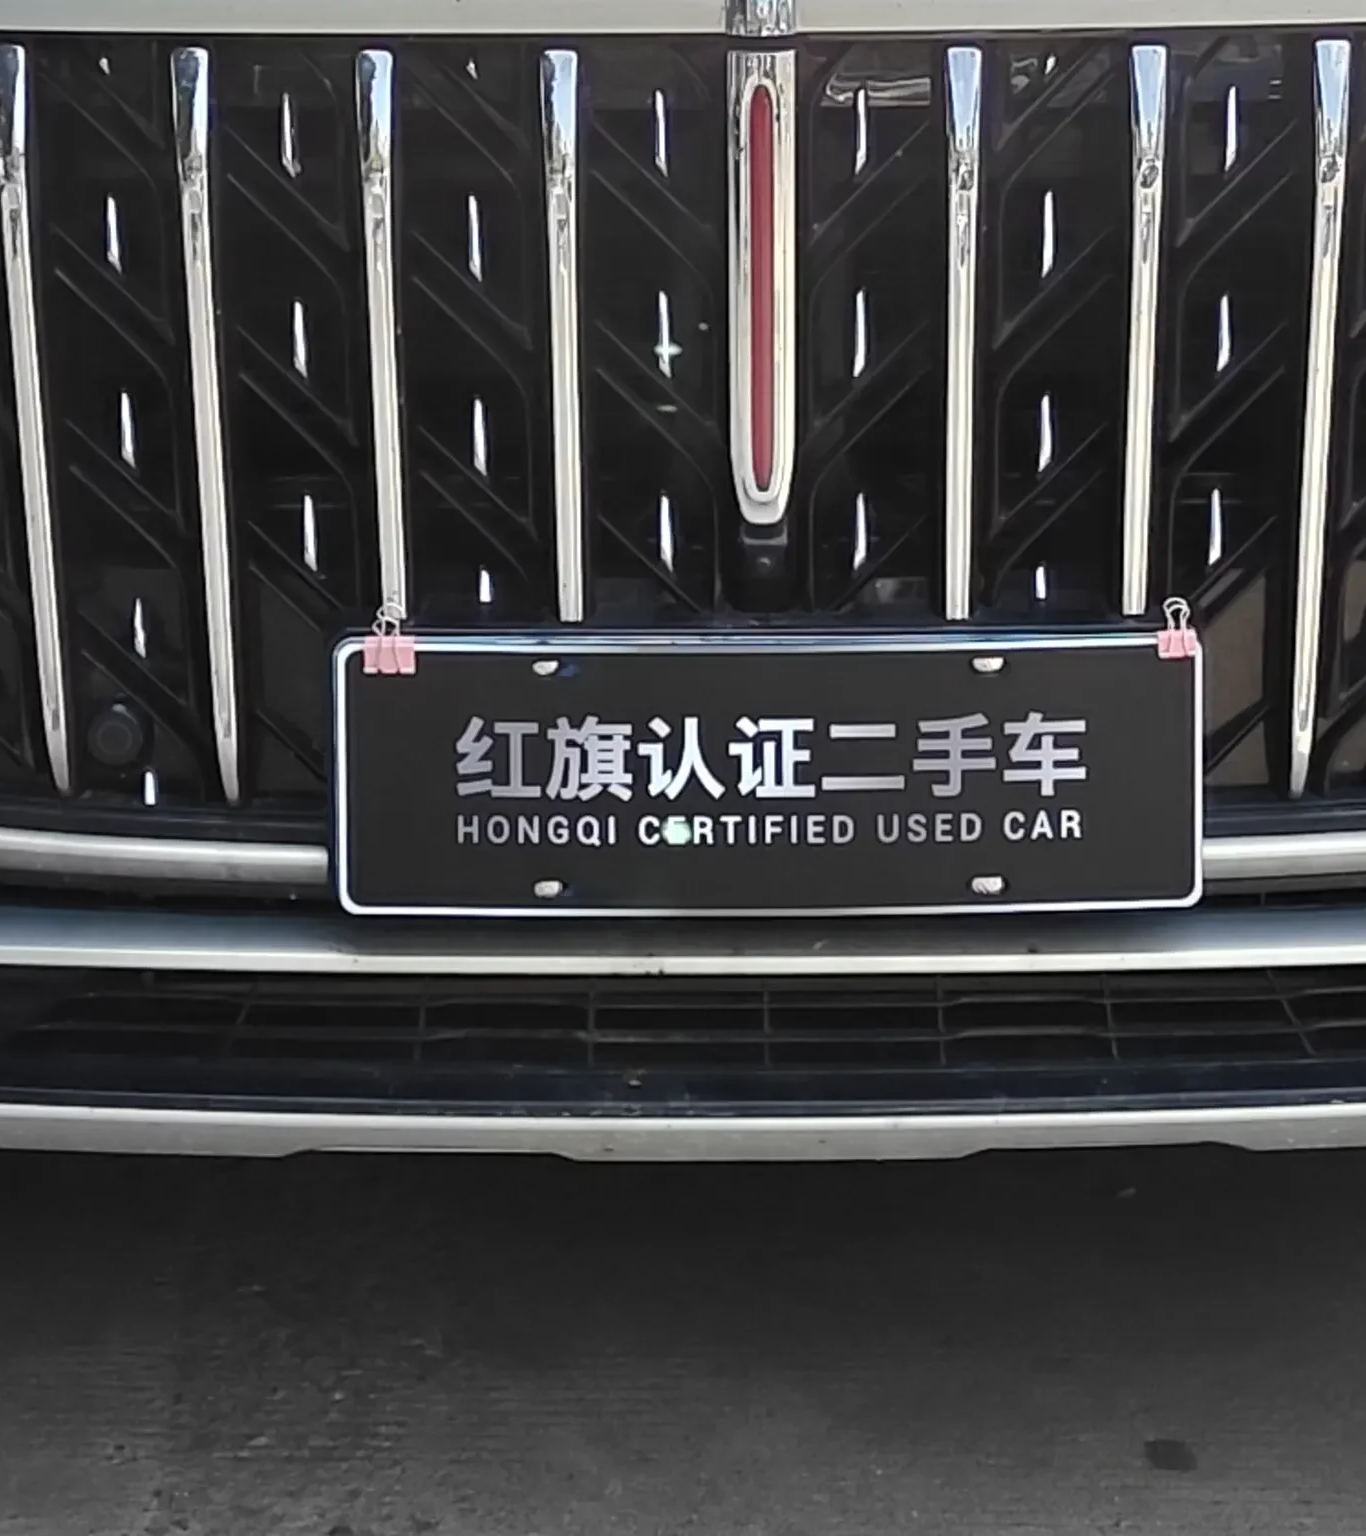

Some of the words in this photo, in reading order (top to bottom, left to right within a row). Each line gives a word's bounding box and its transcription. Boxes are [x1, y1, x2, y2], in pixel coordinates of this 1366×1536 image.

[455, 712, 1089, 802] 红旗认证二手车
[456, 814, 618, 847] HONGQI
[637, 813, 856, 847] CERTIFIED
[876, 812, 983, 845] USED
[1002, 808, 1083, 842] CAR
